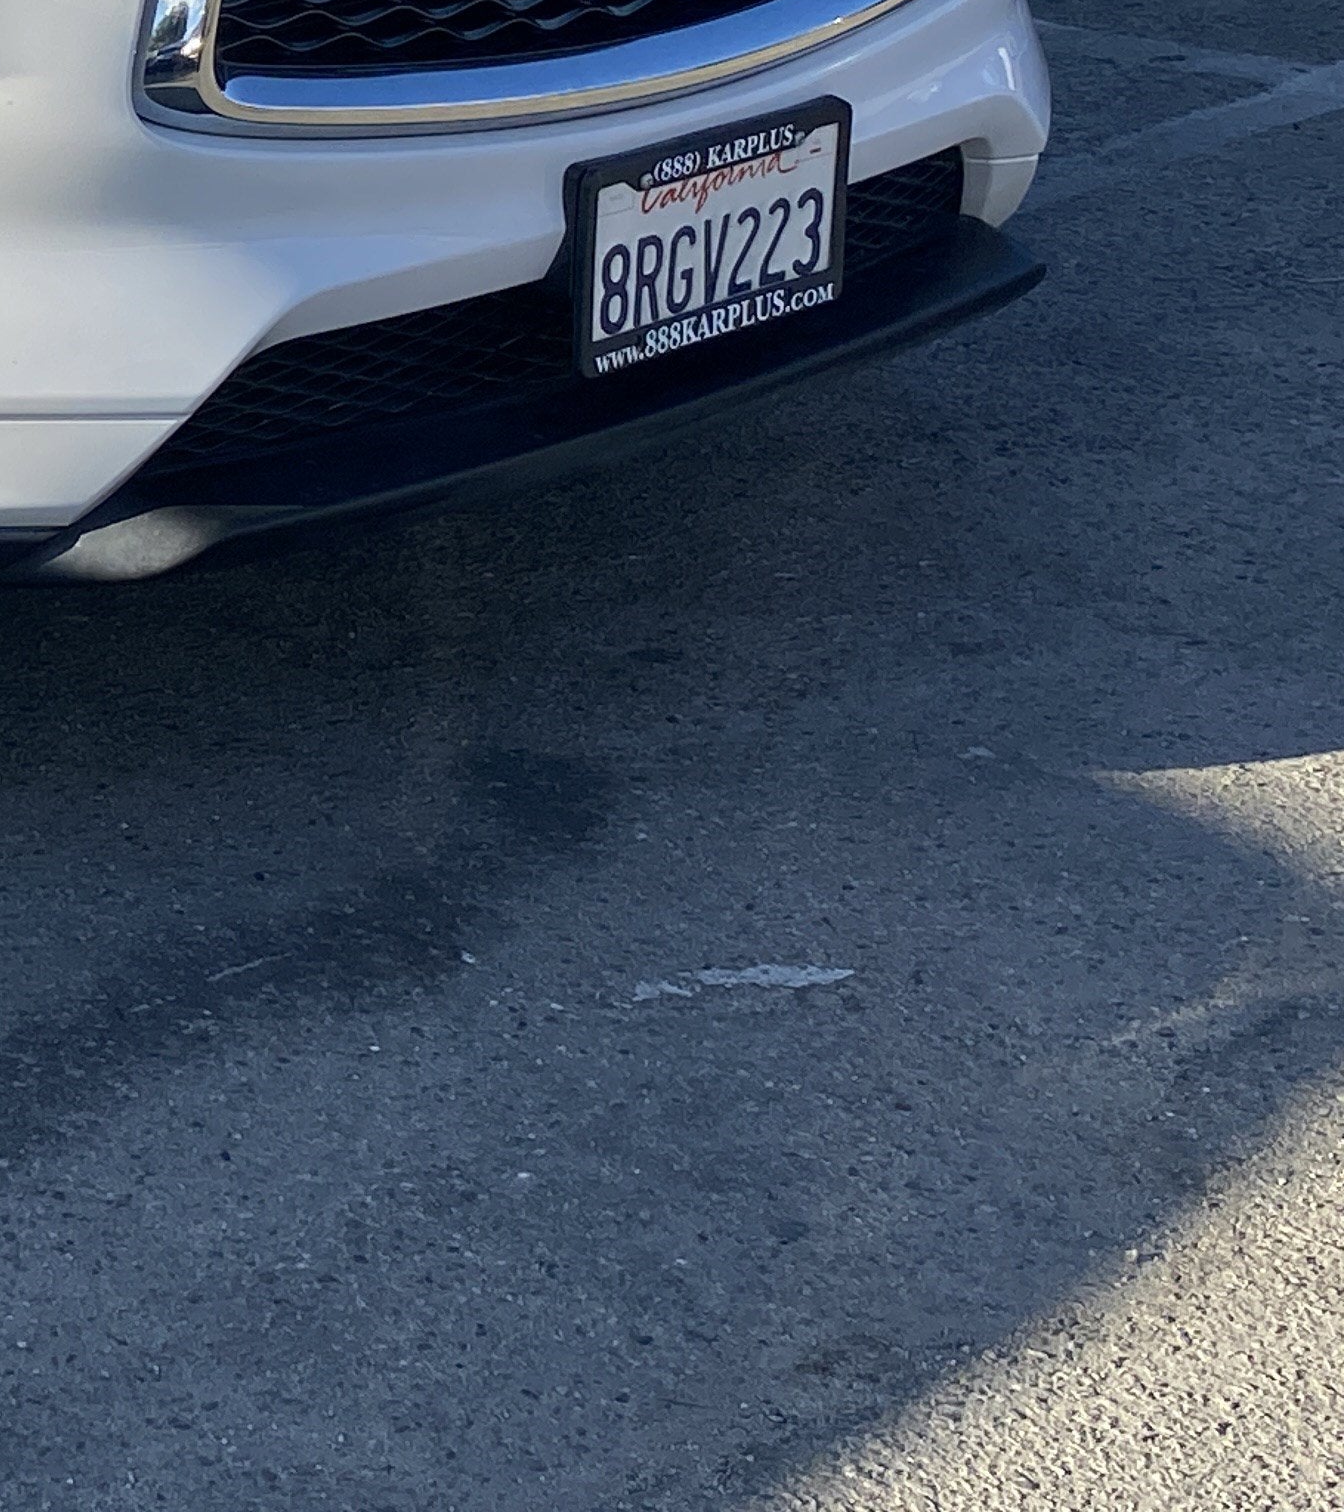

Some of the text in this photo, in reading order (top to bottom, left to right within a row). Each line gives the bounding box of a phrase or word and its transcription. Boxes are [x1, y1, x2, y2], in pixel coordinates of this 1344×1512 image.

[653, 124, 794, 182] (888) KARPLUS
[599, 187, 824, 336] 8RGV223
